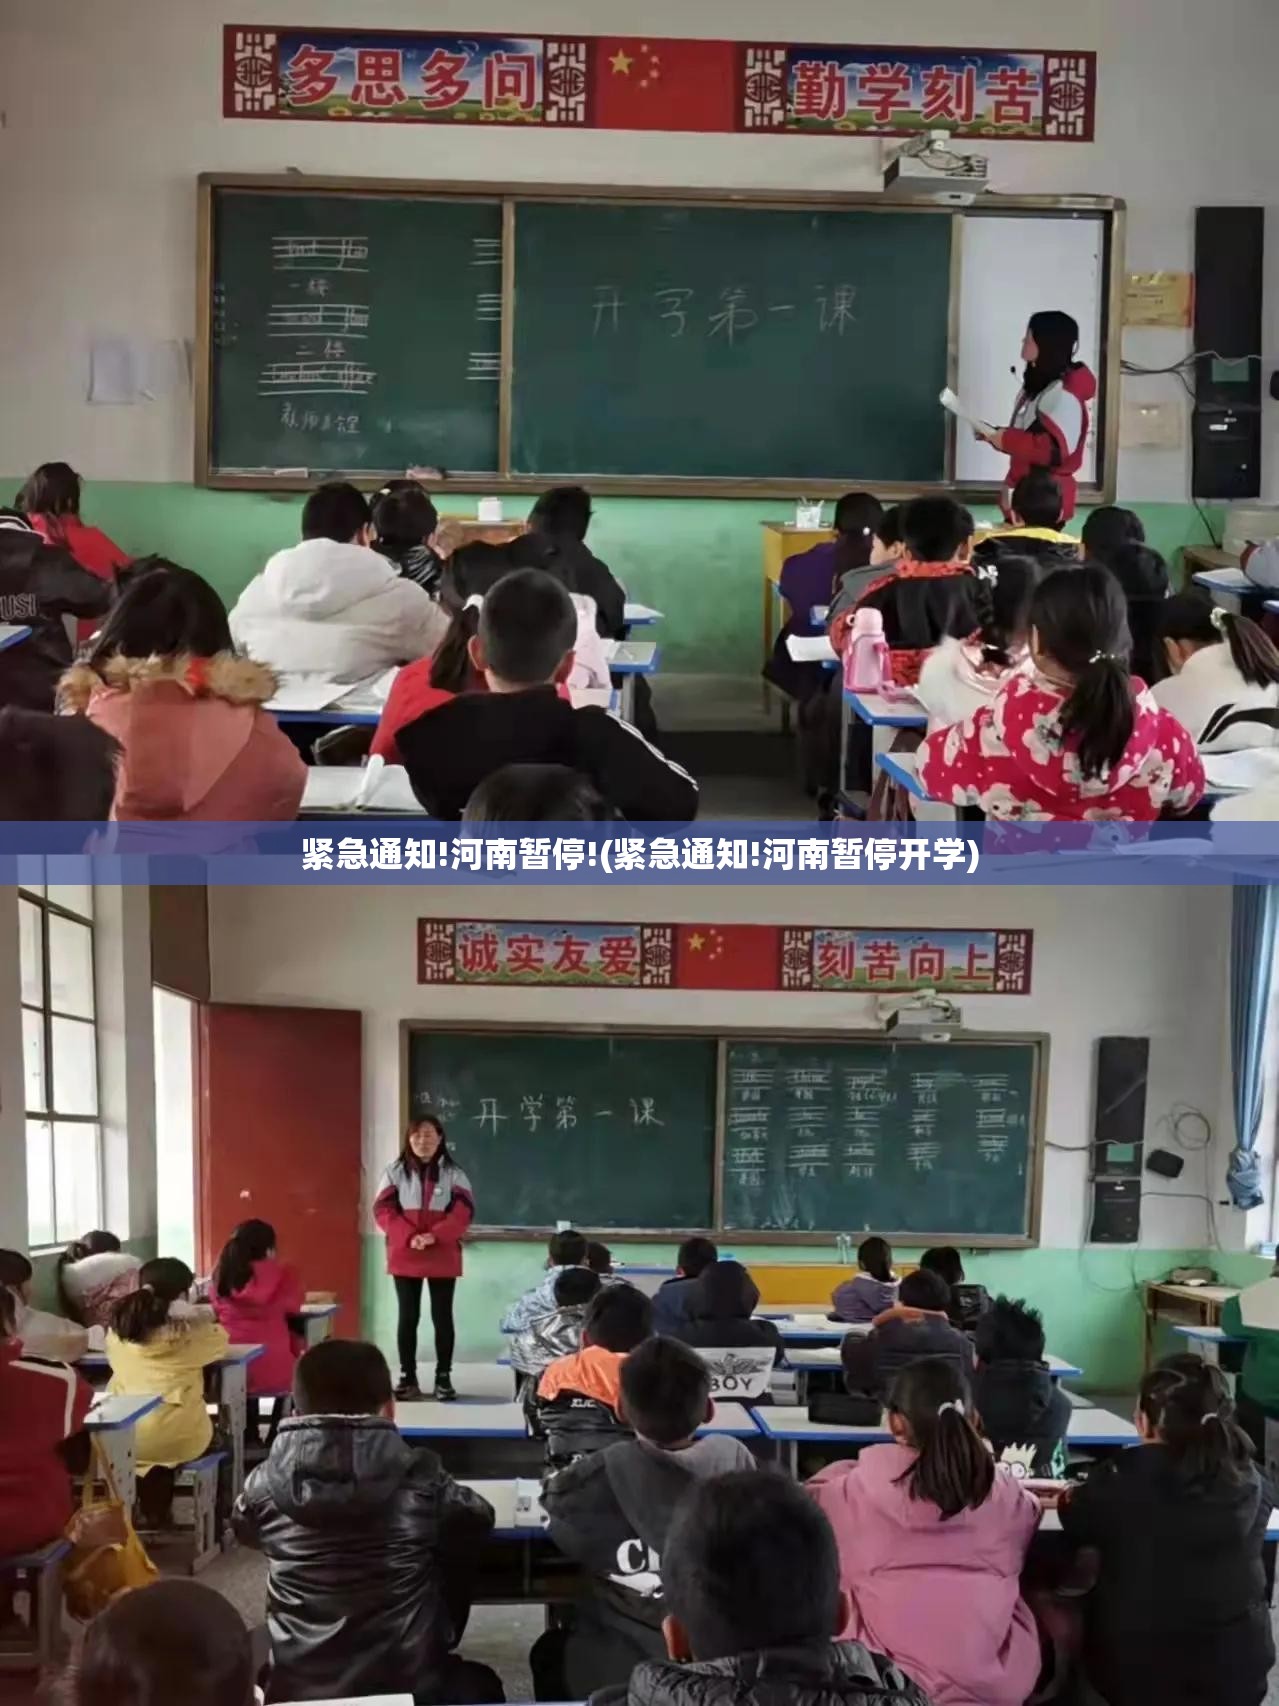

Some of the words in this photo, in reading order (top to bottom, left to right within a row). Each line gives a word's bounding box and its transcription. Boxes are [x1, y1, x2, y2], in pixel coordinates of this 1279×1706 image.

[287, 43, 537, 111] 多思多问
[791, 60, 1041, 125] 勤学刻苦
[457, 931, 638, 977] 诚实友爱
[816, 939, 992, 982] 刻苦向上
[471, 1092, 665, 1137] 开学第一课
[711, 1374, 753, 1391] BOY
